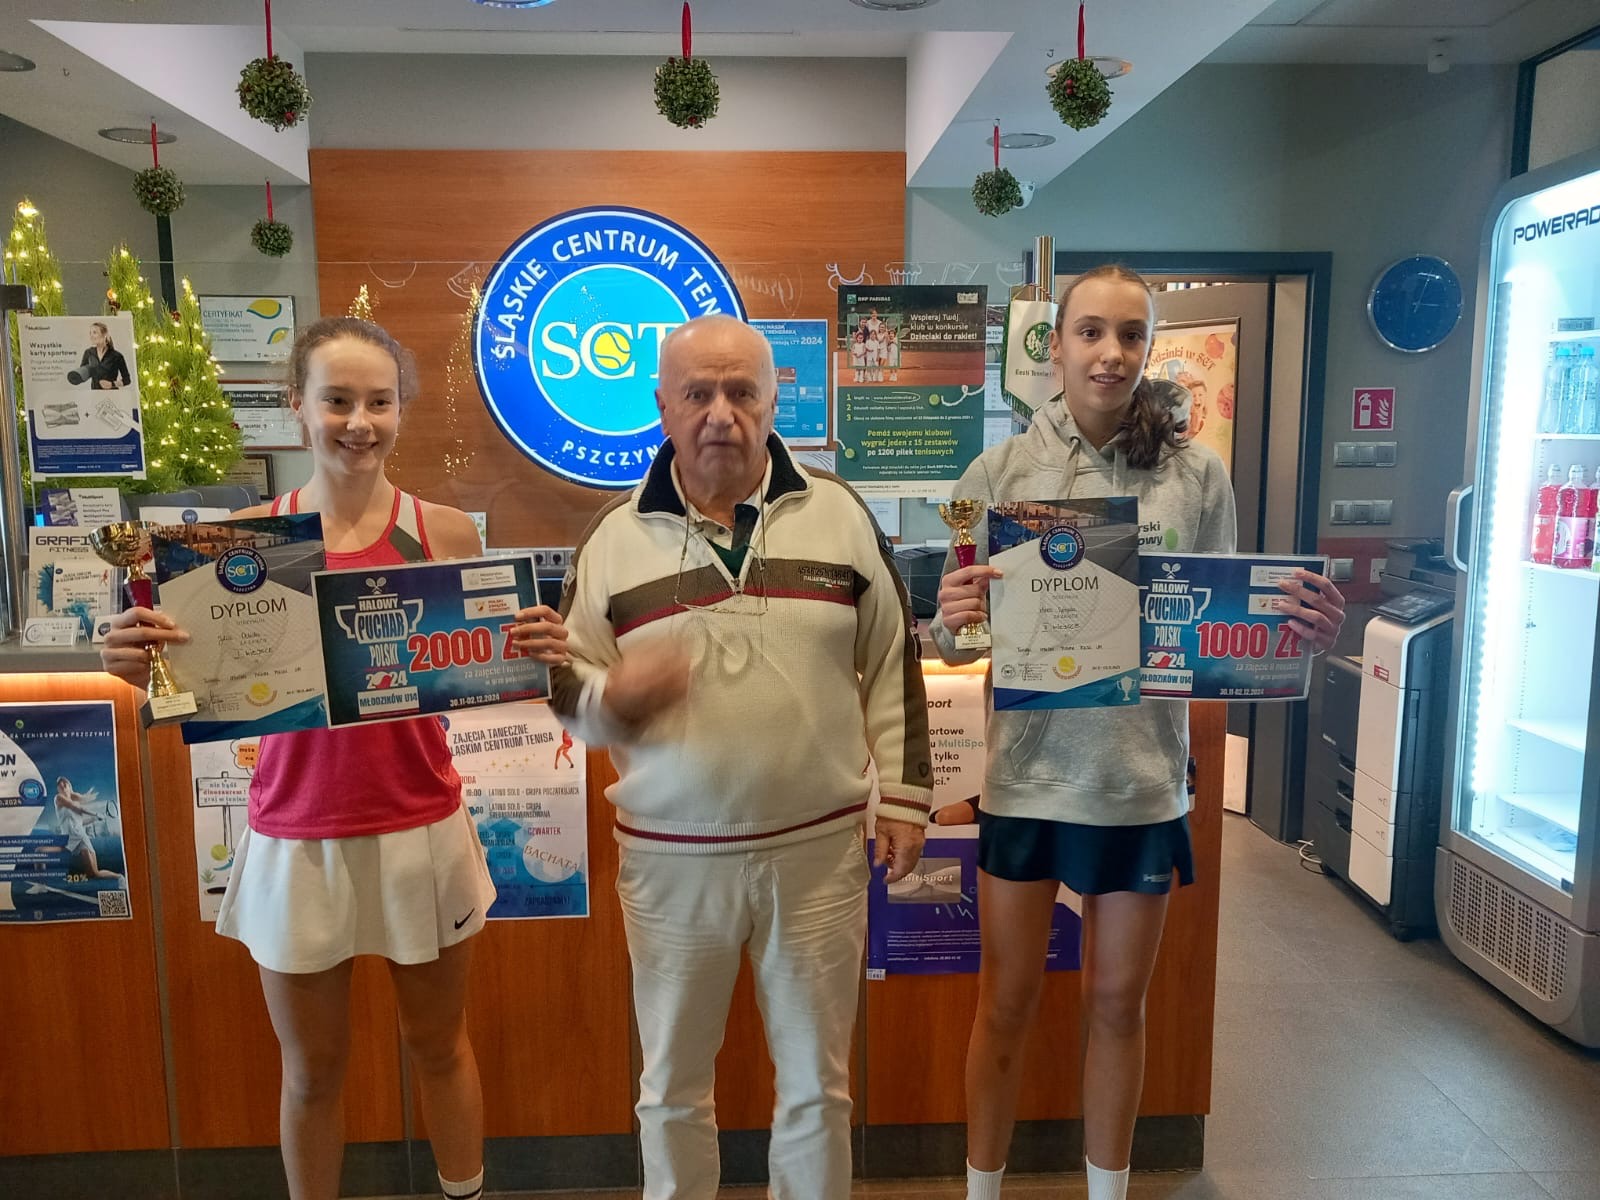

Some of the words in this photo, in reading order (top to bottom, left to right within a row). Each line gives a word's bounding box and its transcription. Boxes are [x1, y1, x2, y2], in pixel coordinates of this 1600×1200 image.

[1513, 204, 1600, 246] POWERAD
[490, 258, 548, 360] ŚLĄSKIE
[551, 229, 681, 272] CENTRUM
[203, 310, 244, 319] CERTYFIKAT
[910, 313, 941, 322] Wspieraj
[942, 313, 960, 322] Twój
[801, 336, 824, 345] 2024
[910, 332, 942, 340] Dzieciaki
[943, 332, 952, 340] do
[953, 332, 977, 340] rakiet!
[30, 342, 62, 350] Wszystkie
[30, 350, 47, 358] karty
[48, 350, 78, 358] sportowe
[846, 393, 852, 401] 1
[846, 403, 852, 411] 2
[846, 413, 852, 421] 3
[892, 430, 923, 438] swojemu
[861, 439, 887, 448] wygrać
[887, 439, 908, 447] jeden
[924, 438, 959, 446] zestawów
[877, 448, 895, 456] 1200
[914, 448, 954, 457] tenisowych
[1049, 542, 1076, 554] SCT
[227, 563, 256, 578] SCT
[1031, 575, 1099, 593] DYPLOM
[1151, 582, 1190, 595] HALOWY
[211, 598, 287, 620] DYPLOM
[359, 597, 400, 612] HALOWY
[1148, 596, 1190, 622] PUCHAR
[358, 611, 405, 641] PUCHAR
[1154, 625, 1181, 647] POLSKI
[1195, 620, 1270, 660] 1000
[369, 642, 400, 667] POLSKI
[407, 626, 494, 674] 2000
[1179, 675, 1192, 684] U14
[359, 694, 403, 708] MŁODZIKÓW
[405, 692, 418, 702] U14
[70, 730, 111, 738] PSZCZYNIE
[453, 727, 486, 745] ZAJĘCIA
[486, 723, 529, 740] TANECZNE
[929, 727, 964, 736] ortowe
[484, 737, 523, 753] CENTRUM
[525, 731, 554, 747] TENISA
[938, 738, 984, 750] MultiSpo
[934, 752, 960, 763] tylko
[526, 787, 542, 796] GRUPA
[526, 802, 542, 811] GRUPA
[527, 826, 561, 836] CZWARTEK
[524, 845, 578, 872] BACHATA
[62, 874, 89, 884] -20%
